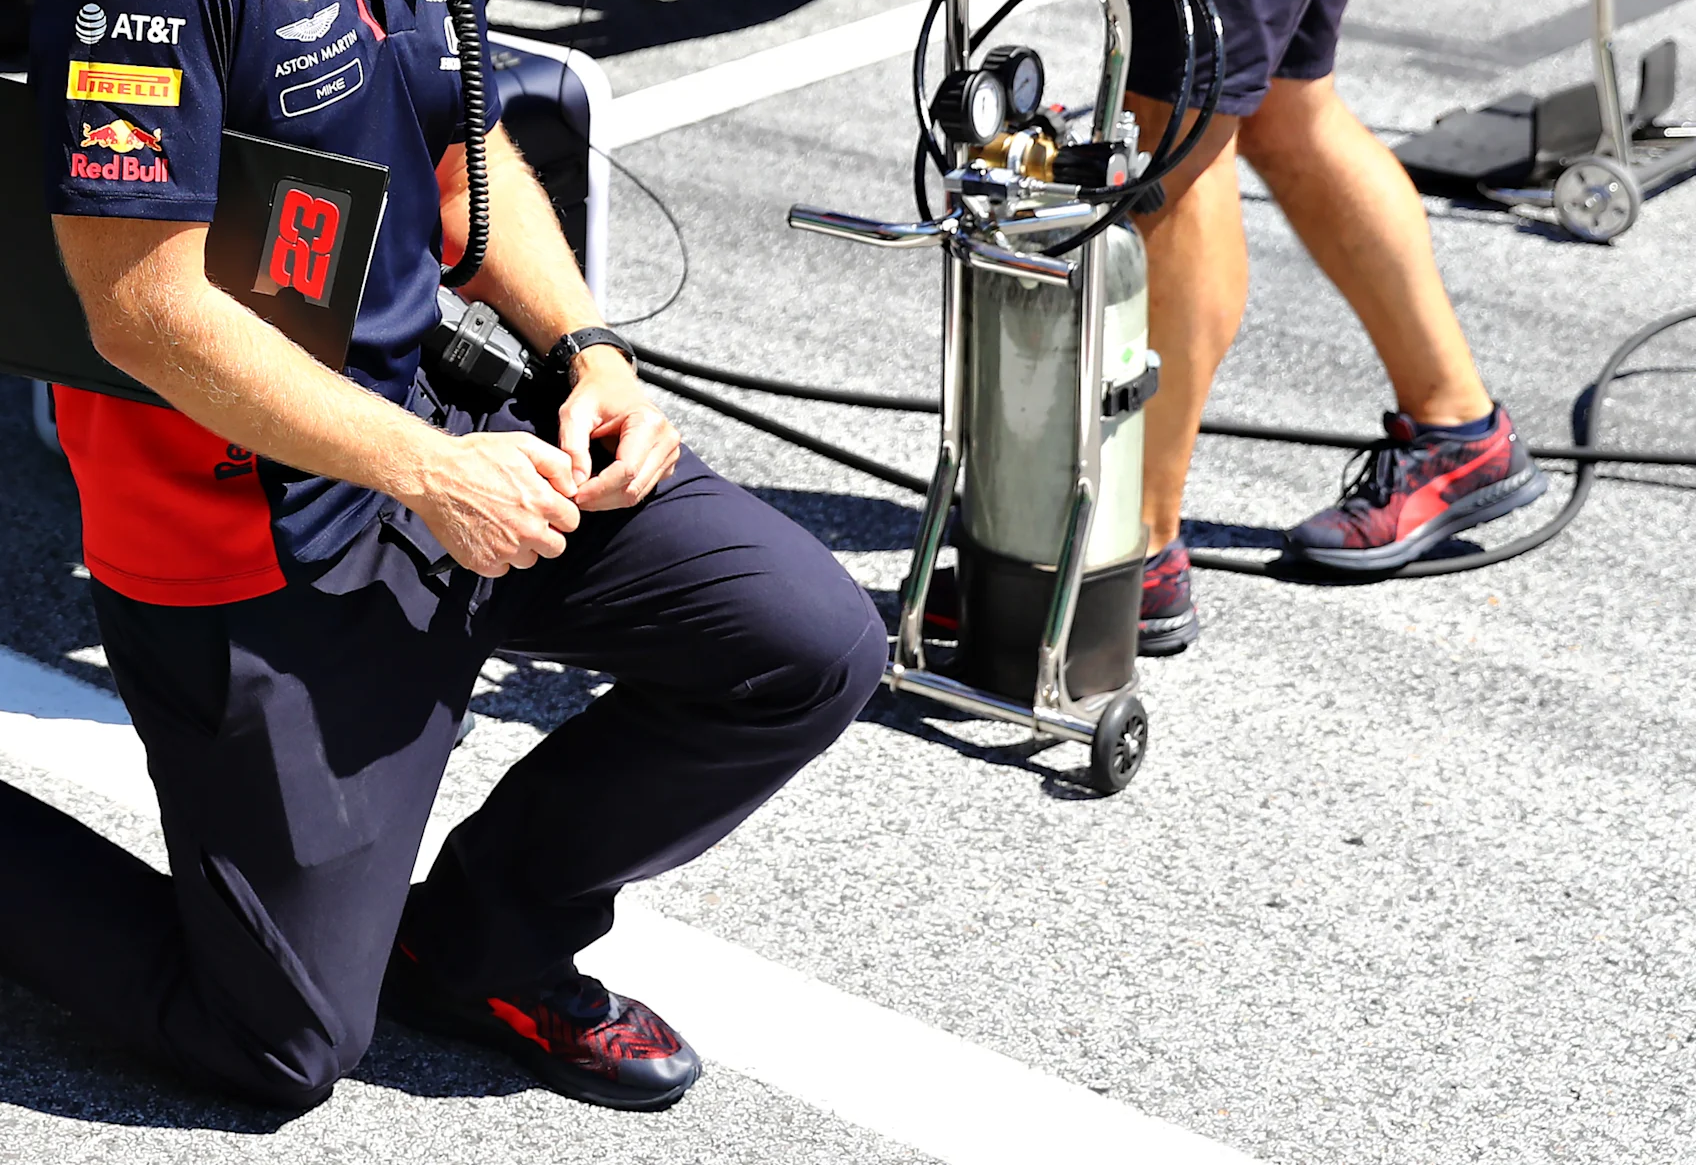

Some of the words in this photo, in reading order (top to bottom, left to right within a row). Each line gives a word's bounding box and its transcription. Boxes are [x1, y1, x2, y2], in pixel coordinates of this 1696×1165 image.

[110, 13, 187, 45] AT&T
[274, 52, 320, 78] ASTON
[320, 28, 358, 62] MARTIN
[77, 69, 172, 98] PIRELLI
[315, 77, 347, 100] MIKE
[70, 152, 120, 181] Red
[121, 154, 169, 184] Bull
[269, 188, 341, 301] 23
[213, 443, 253, 481] Re
